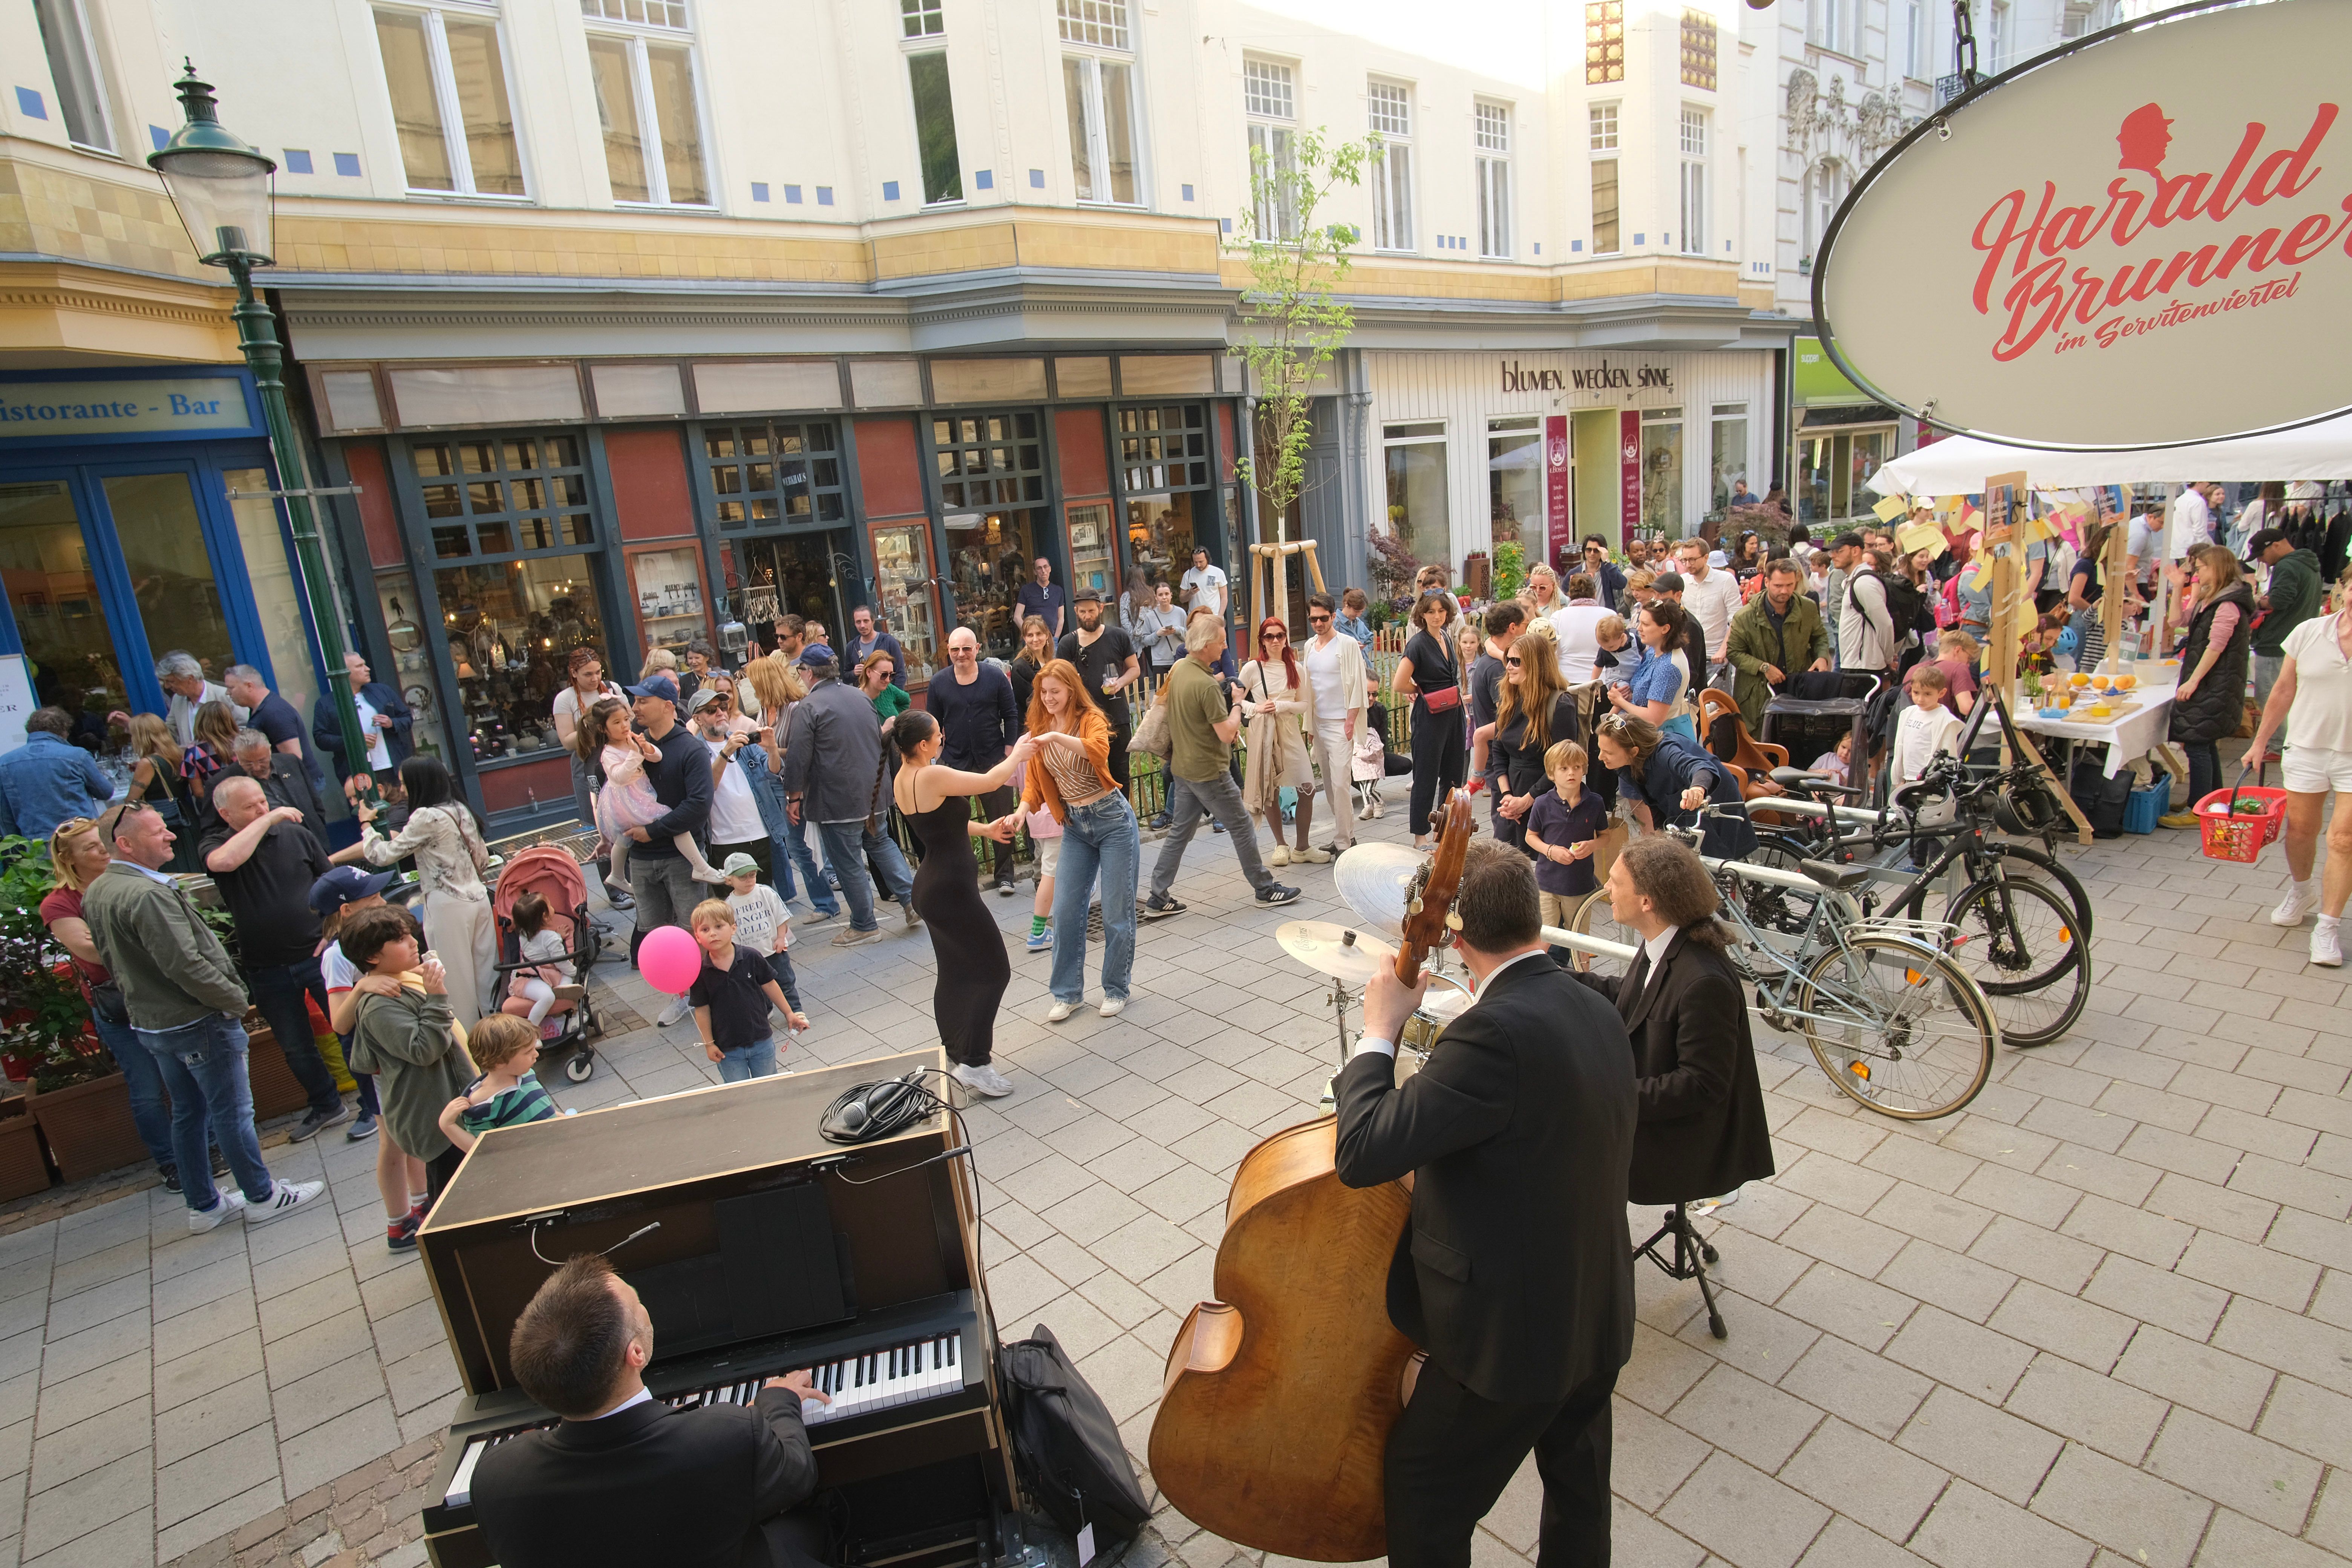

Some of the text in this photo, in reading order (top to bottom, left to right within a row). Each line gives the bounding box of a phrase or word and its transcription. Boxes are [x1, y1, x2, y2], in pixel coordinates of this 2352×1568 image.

[1972, 103, 2339, 315] Harald
[1992, 193, 2352, 362] Brunne
[2055, 271, 2301, 355] im Servitenviertel
[0, 398, 139, 421] istorante
[167, 394, 220, 415] Bar
[736, 900, 763, 915] FRED
